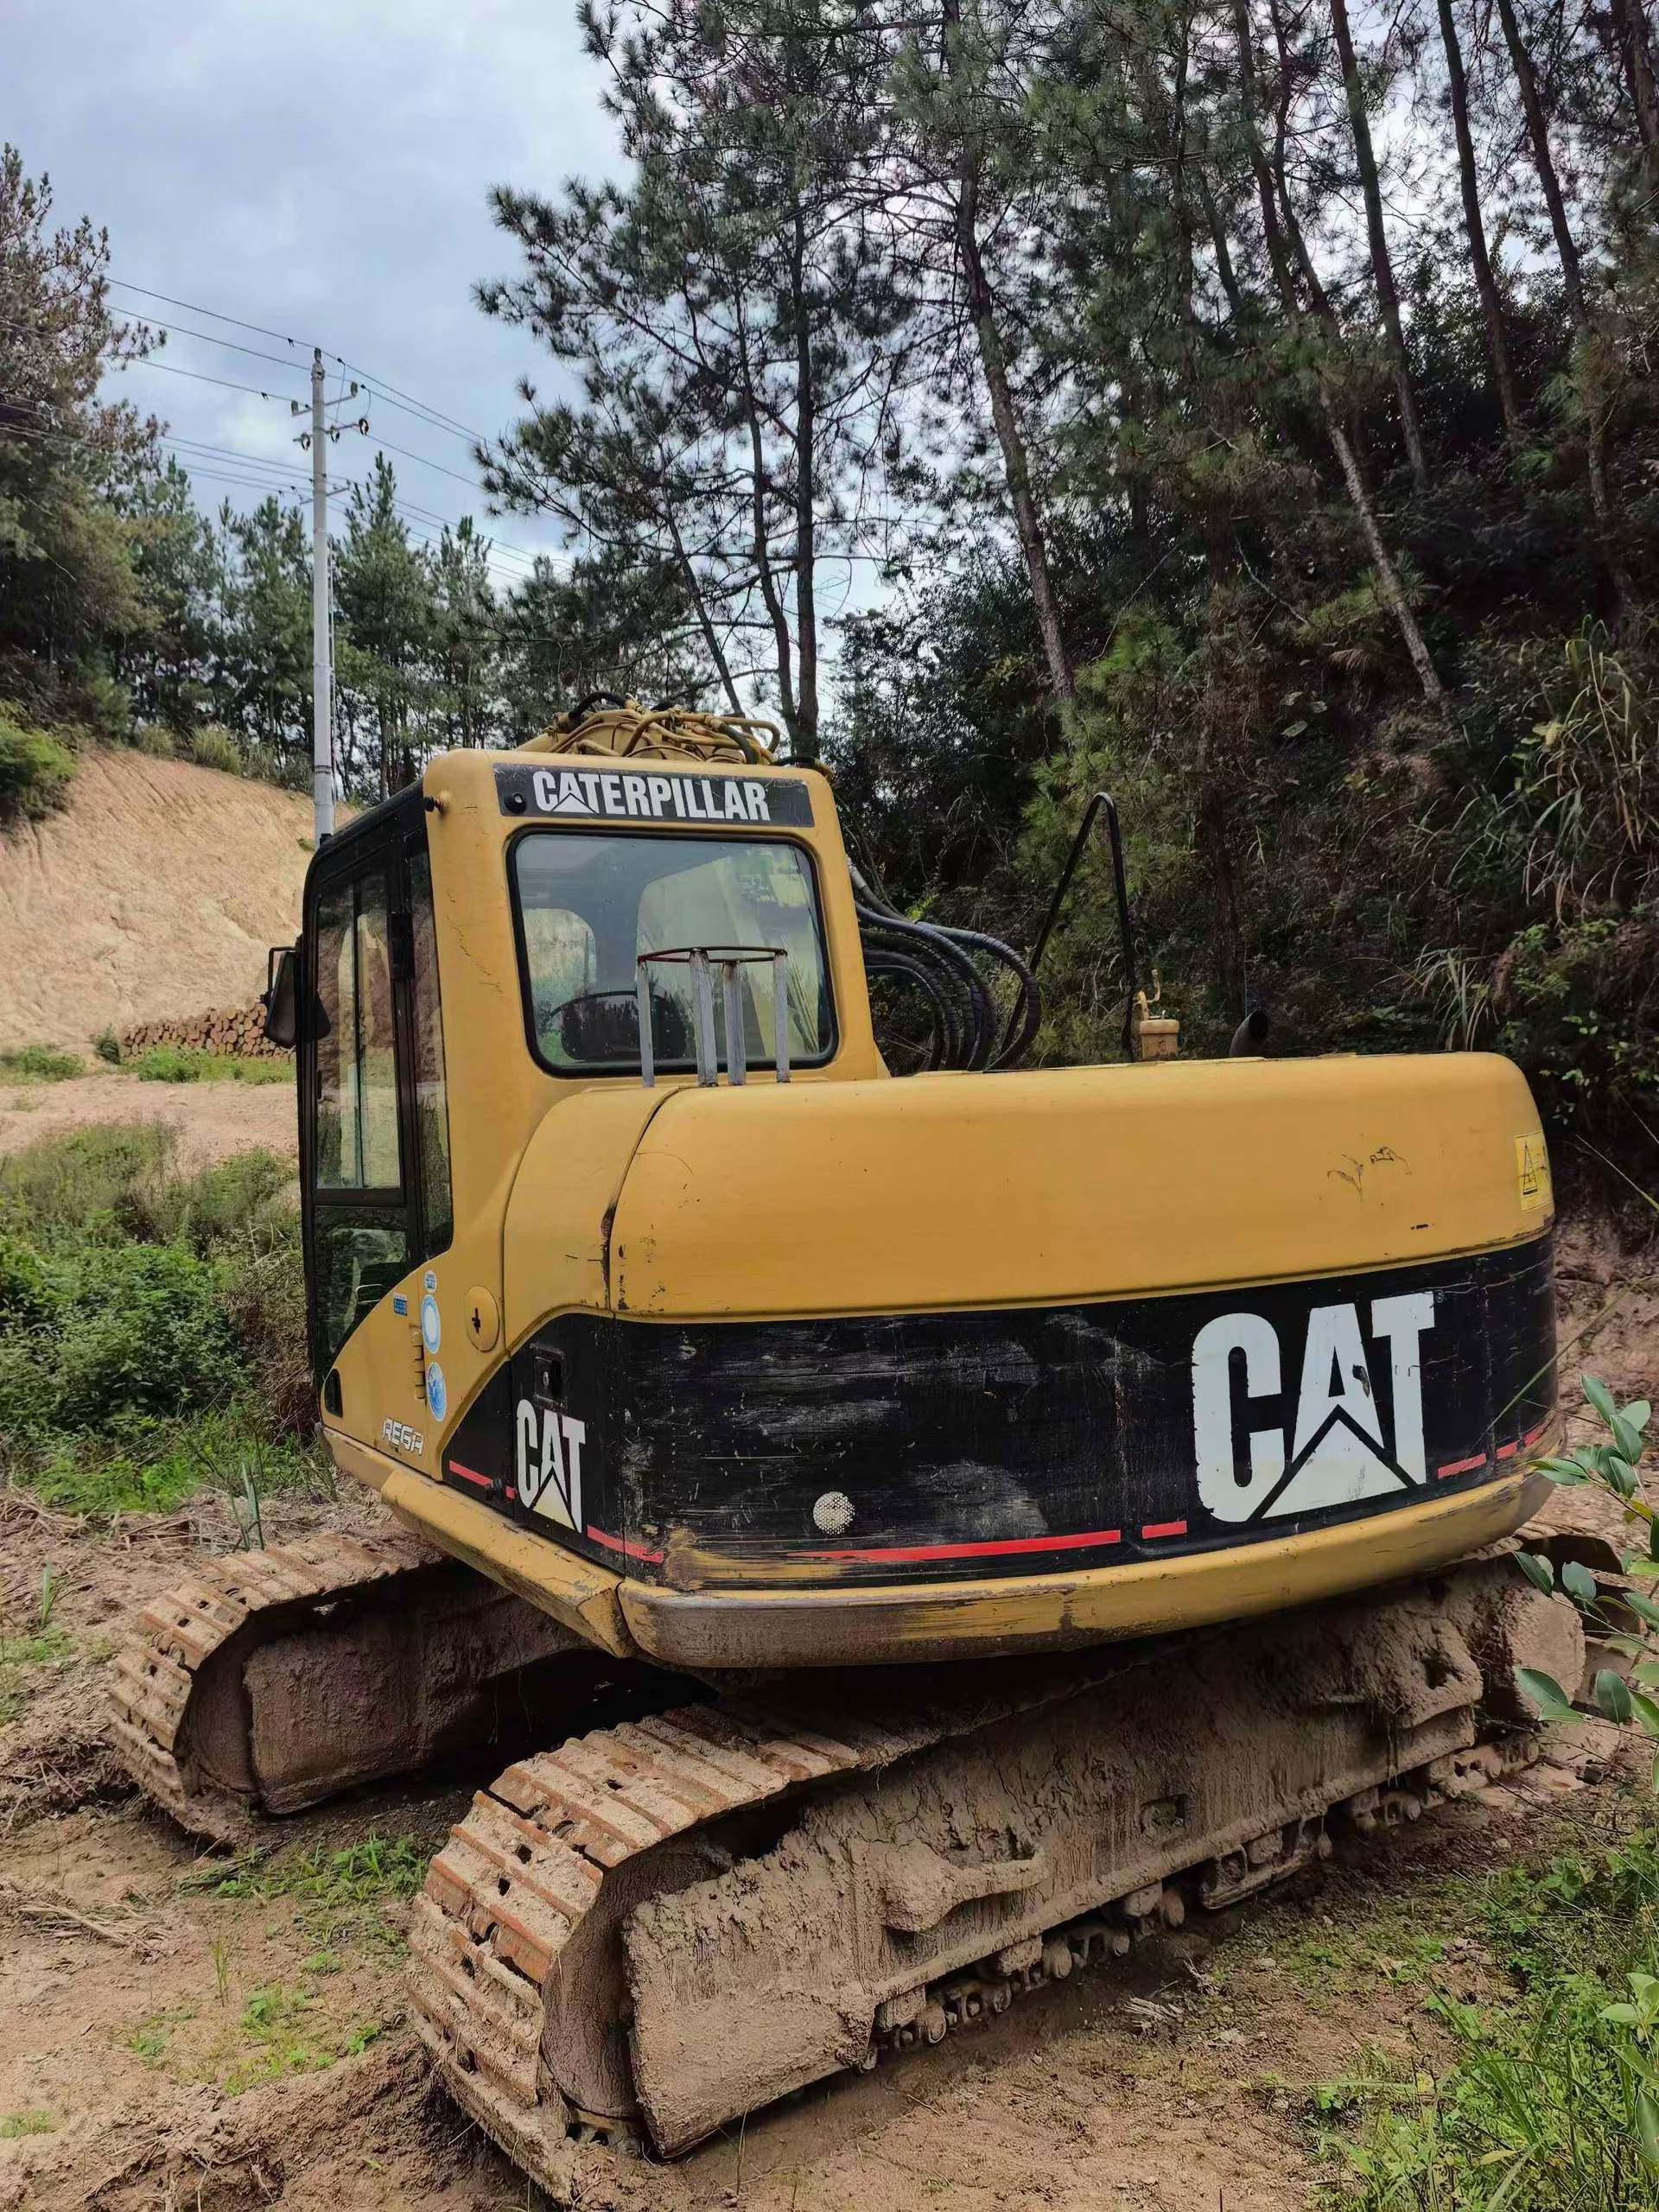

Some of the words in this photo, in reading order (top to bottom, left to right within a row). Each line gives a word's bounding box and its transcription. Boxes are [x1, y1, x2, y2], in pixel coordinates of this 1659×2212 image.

[532, 770, 771, 821] CATERPILLAR
[517, 1399, 586, 1533] CAT
[1192, 1291, 1435, 1522] CAT
